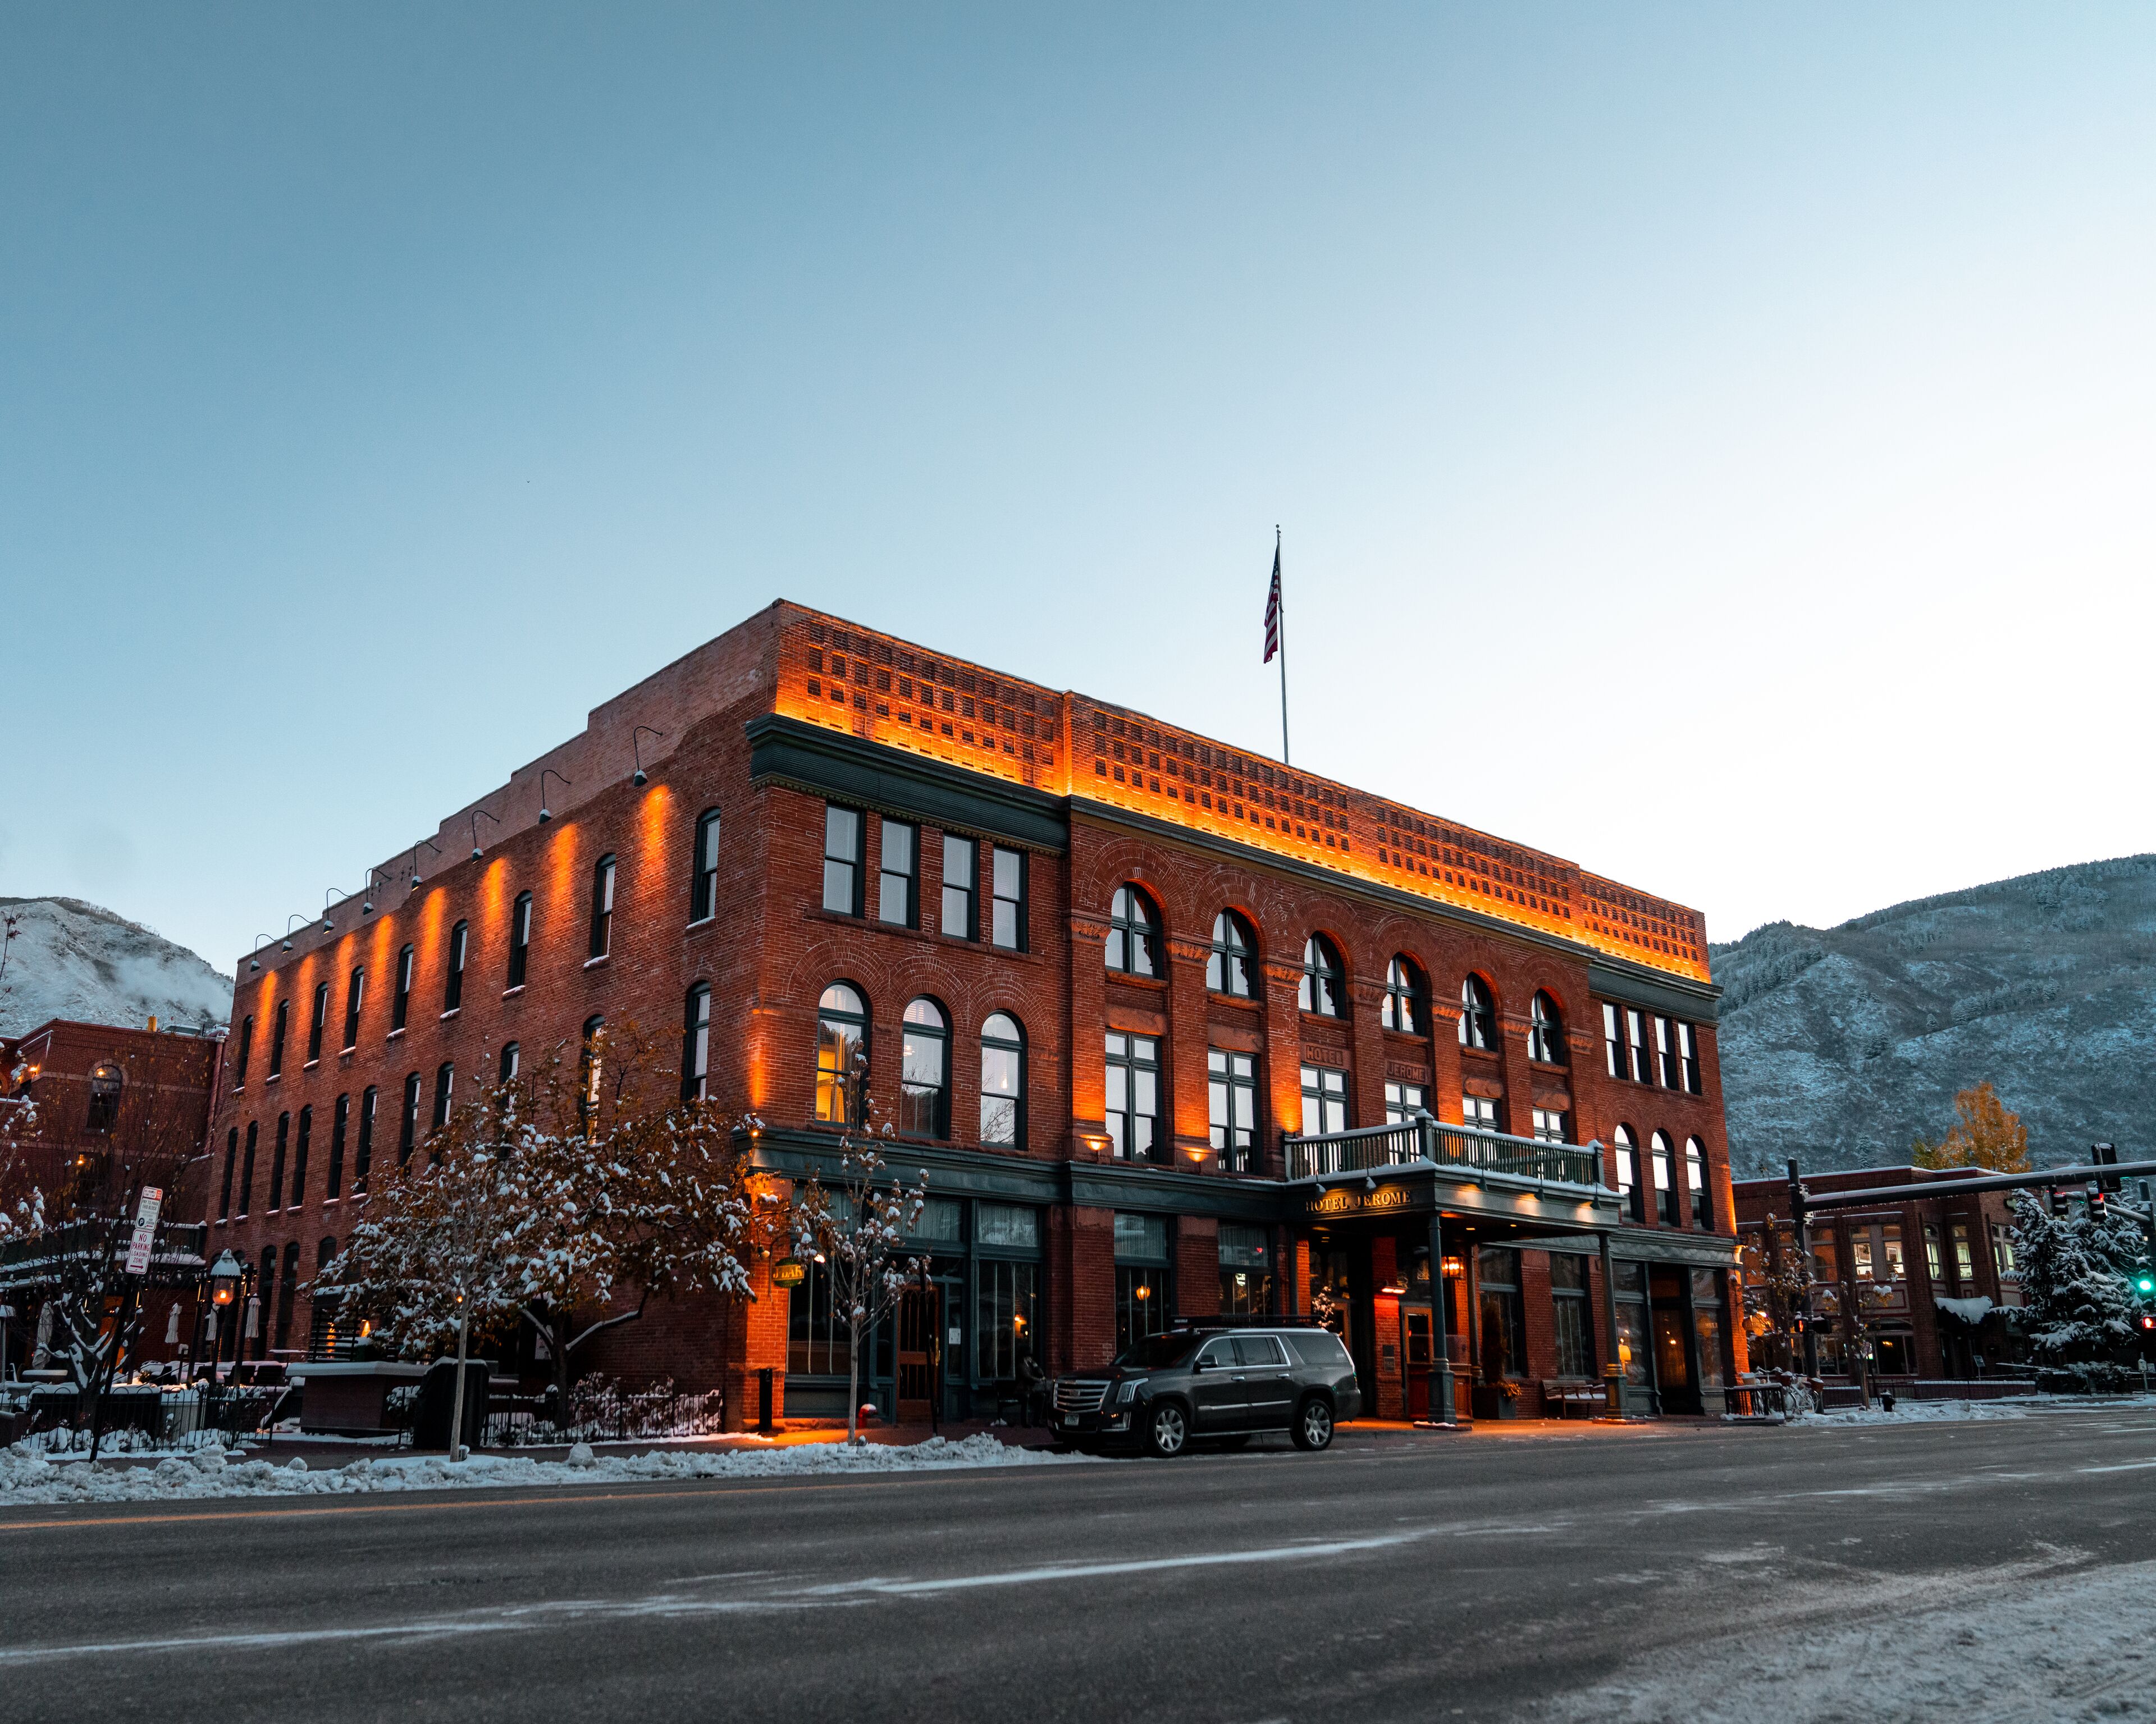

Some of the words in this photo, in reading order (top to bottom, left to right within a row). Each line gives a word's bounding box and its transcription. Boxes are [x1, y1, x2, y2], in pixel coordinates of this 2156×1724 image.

[1306, 1045, 1343, 1065] HOTEL
[1387, 1060, 1425, 1081] JEROME
[1305, 1196, 1347, 1211] HOTEL
[1354, 1190, 1411, 1207] JEROME
[131, 1242, 150, 1251] PARKING
[139, 1233, 147, 1242] NO
